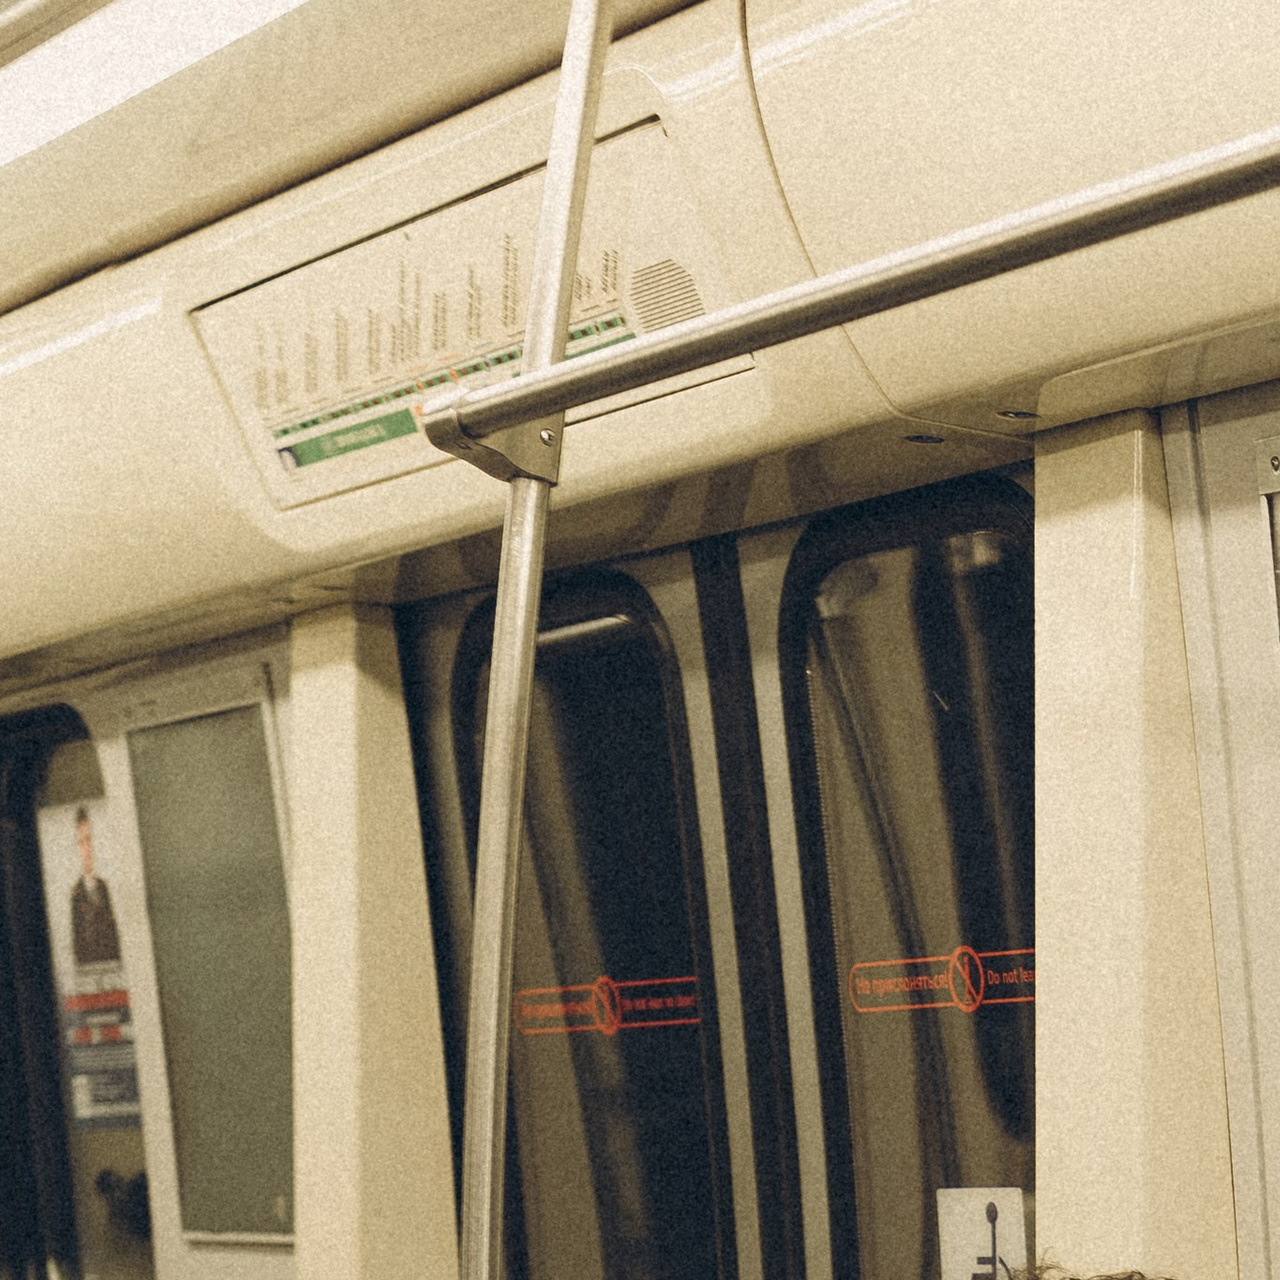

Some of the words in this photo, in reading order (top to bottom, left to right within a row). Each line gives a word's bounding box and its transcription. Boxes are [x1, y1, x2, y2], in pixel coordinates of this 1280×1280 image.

[872, 970, 948, 997] прислоняться!
[987, 969, 1000, 985] Do
[1002, 969, 1019, 984] not
[1020, 965, 1036, 983] lea
